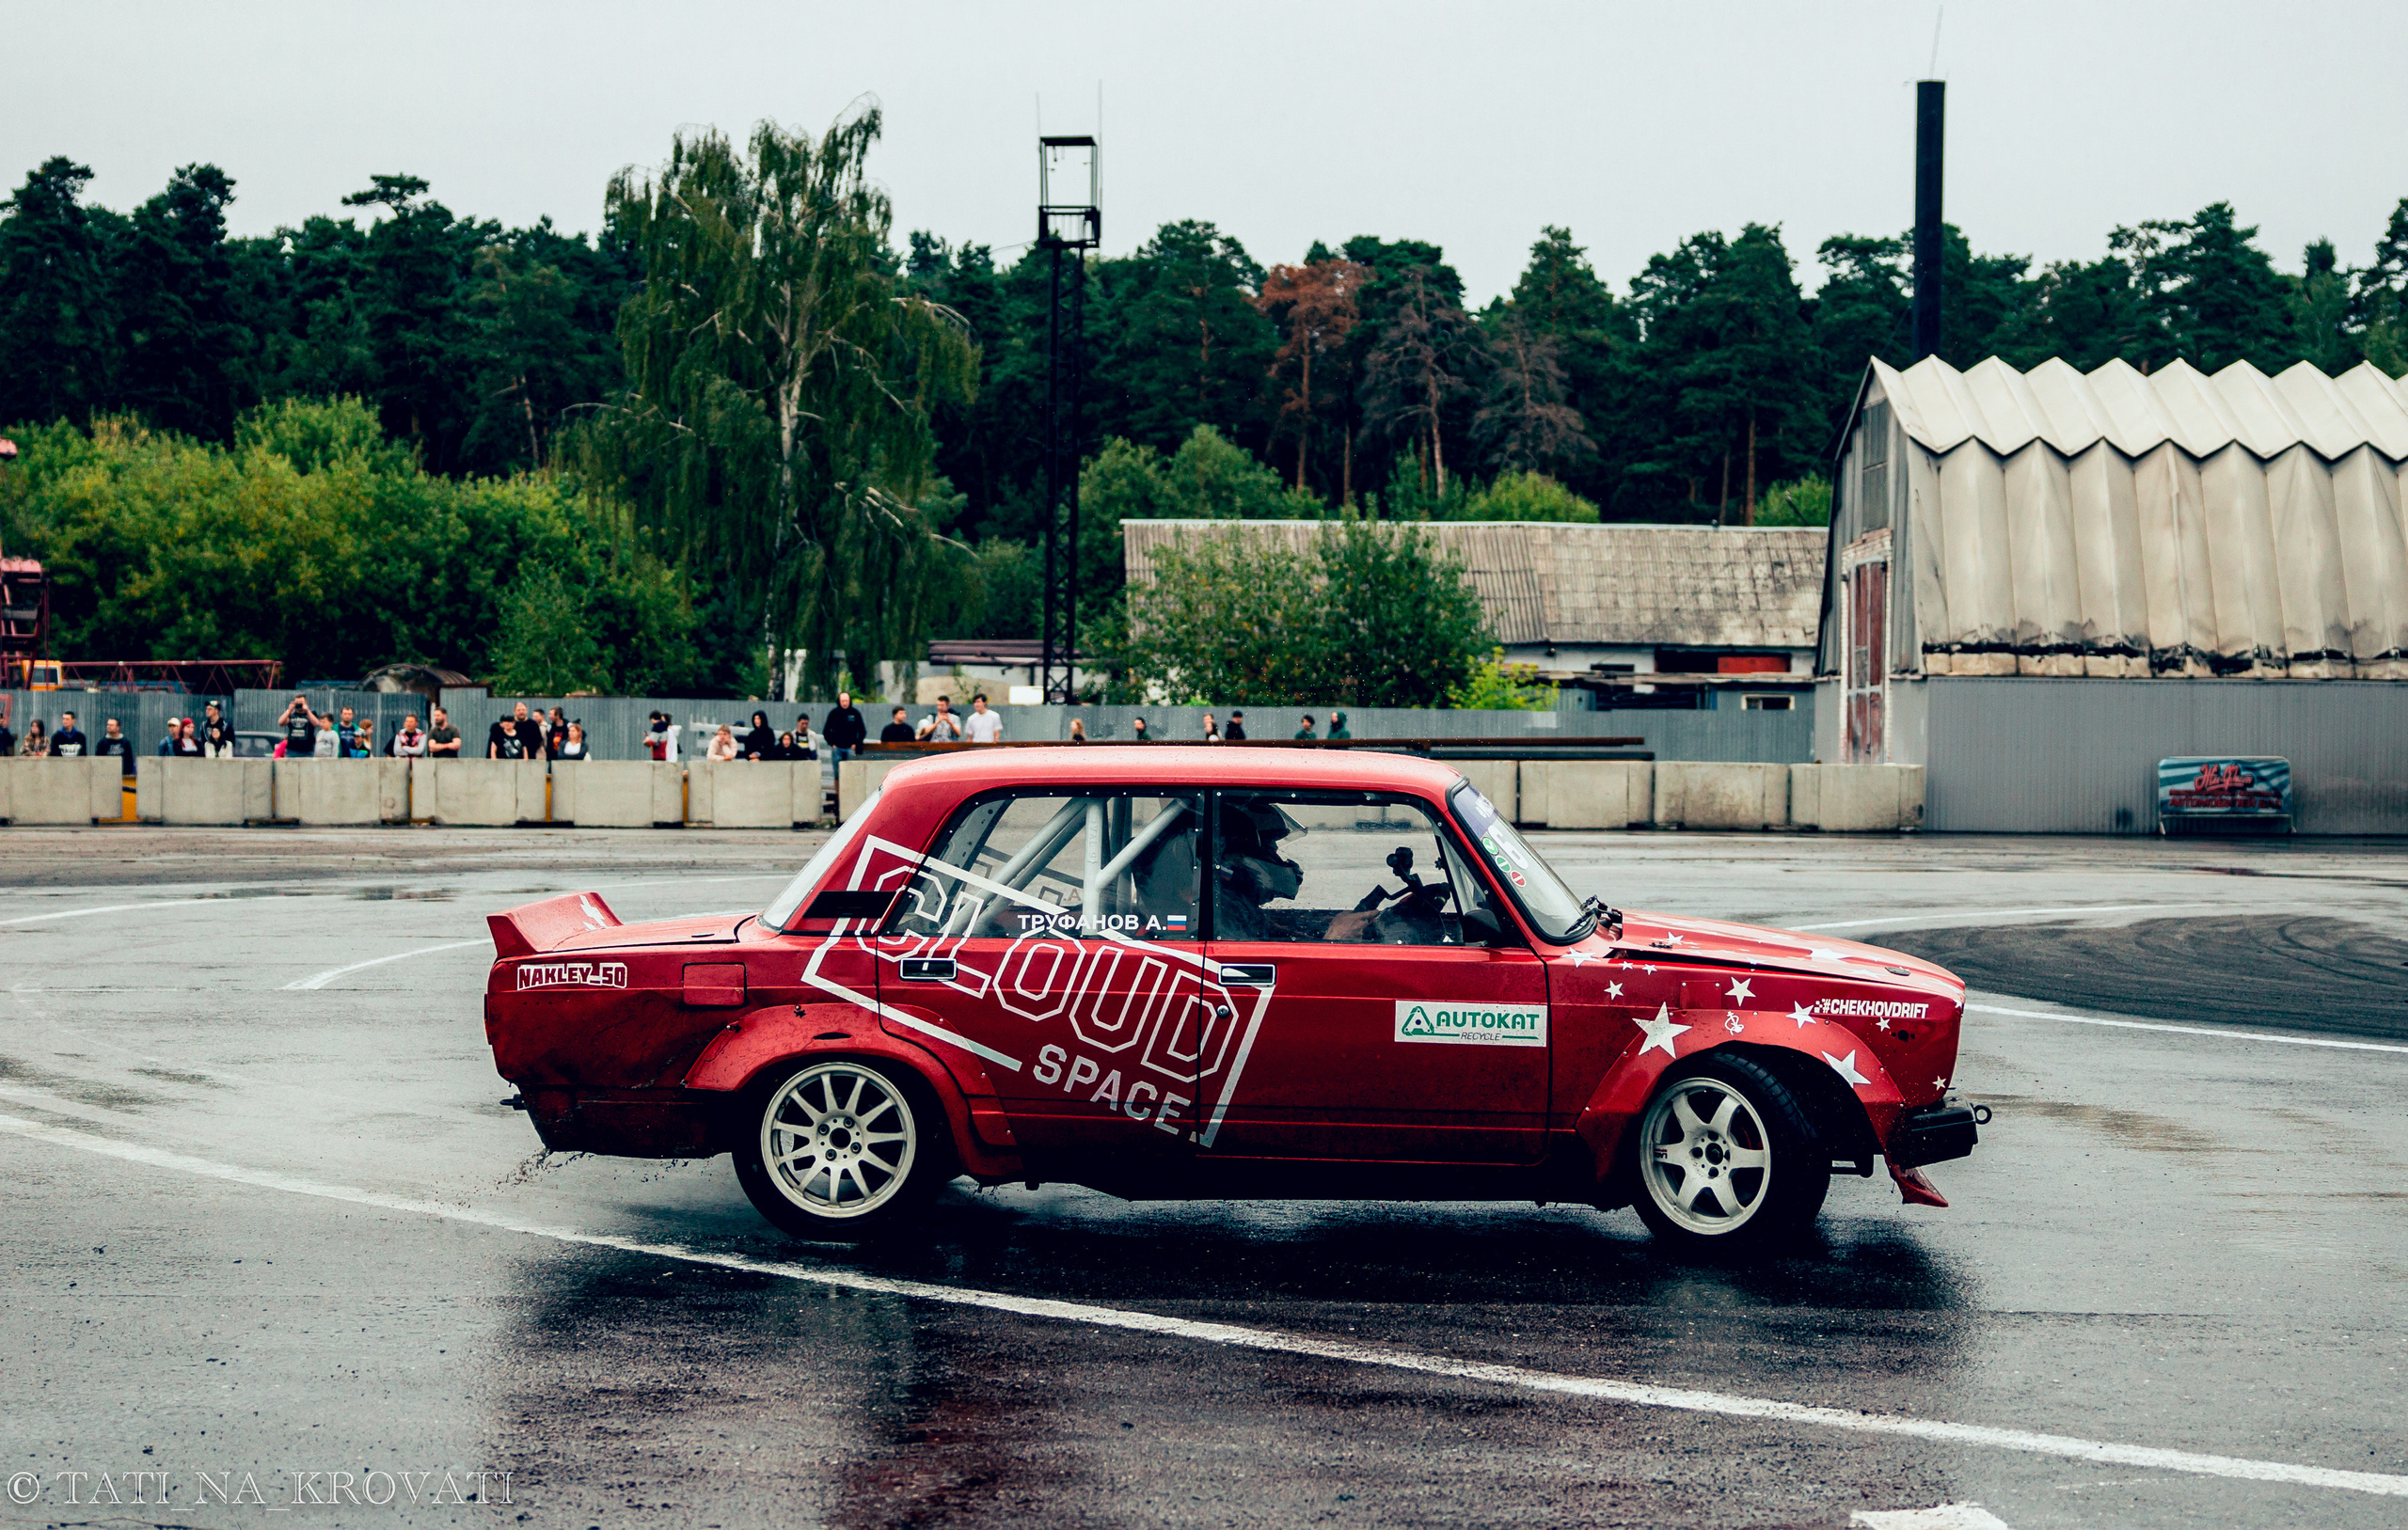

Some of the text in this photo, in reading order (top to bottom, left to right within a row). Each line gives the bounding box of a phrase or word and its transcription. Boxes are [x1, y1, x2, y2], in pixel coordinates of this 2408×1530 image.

[1018, 913, 1167, 931] ТРУФАНОВ А.
[856, 865, 1240, 1083] CLOUD
[1822, 999, 1929, 1018] #CHEKHOVDRIFT
[1436, 1011, 1540, 1030] AUTOKAT
[1461, 1032, 1501, 1041] RECYCLE
[1033, 1043, 1192, 1135] SPACE
